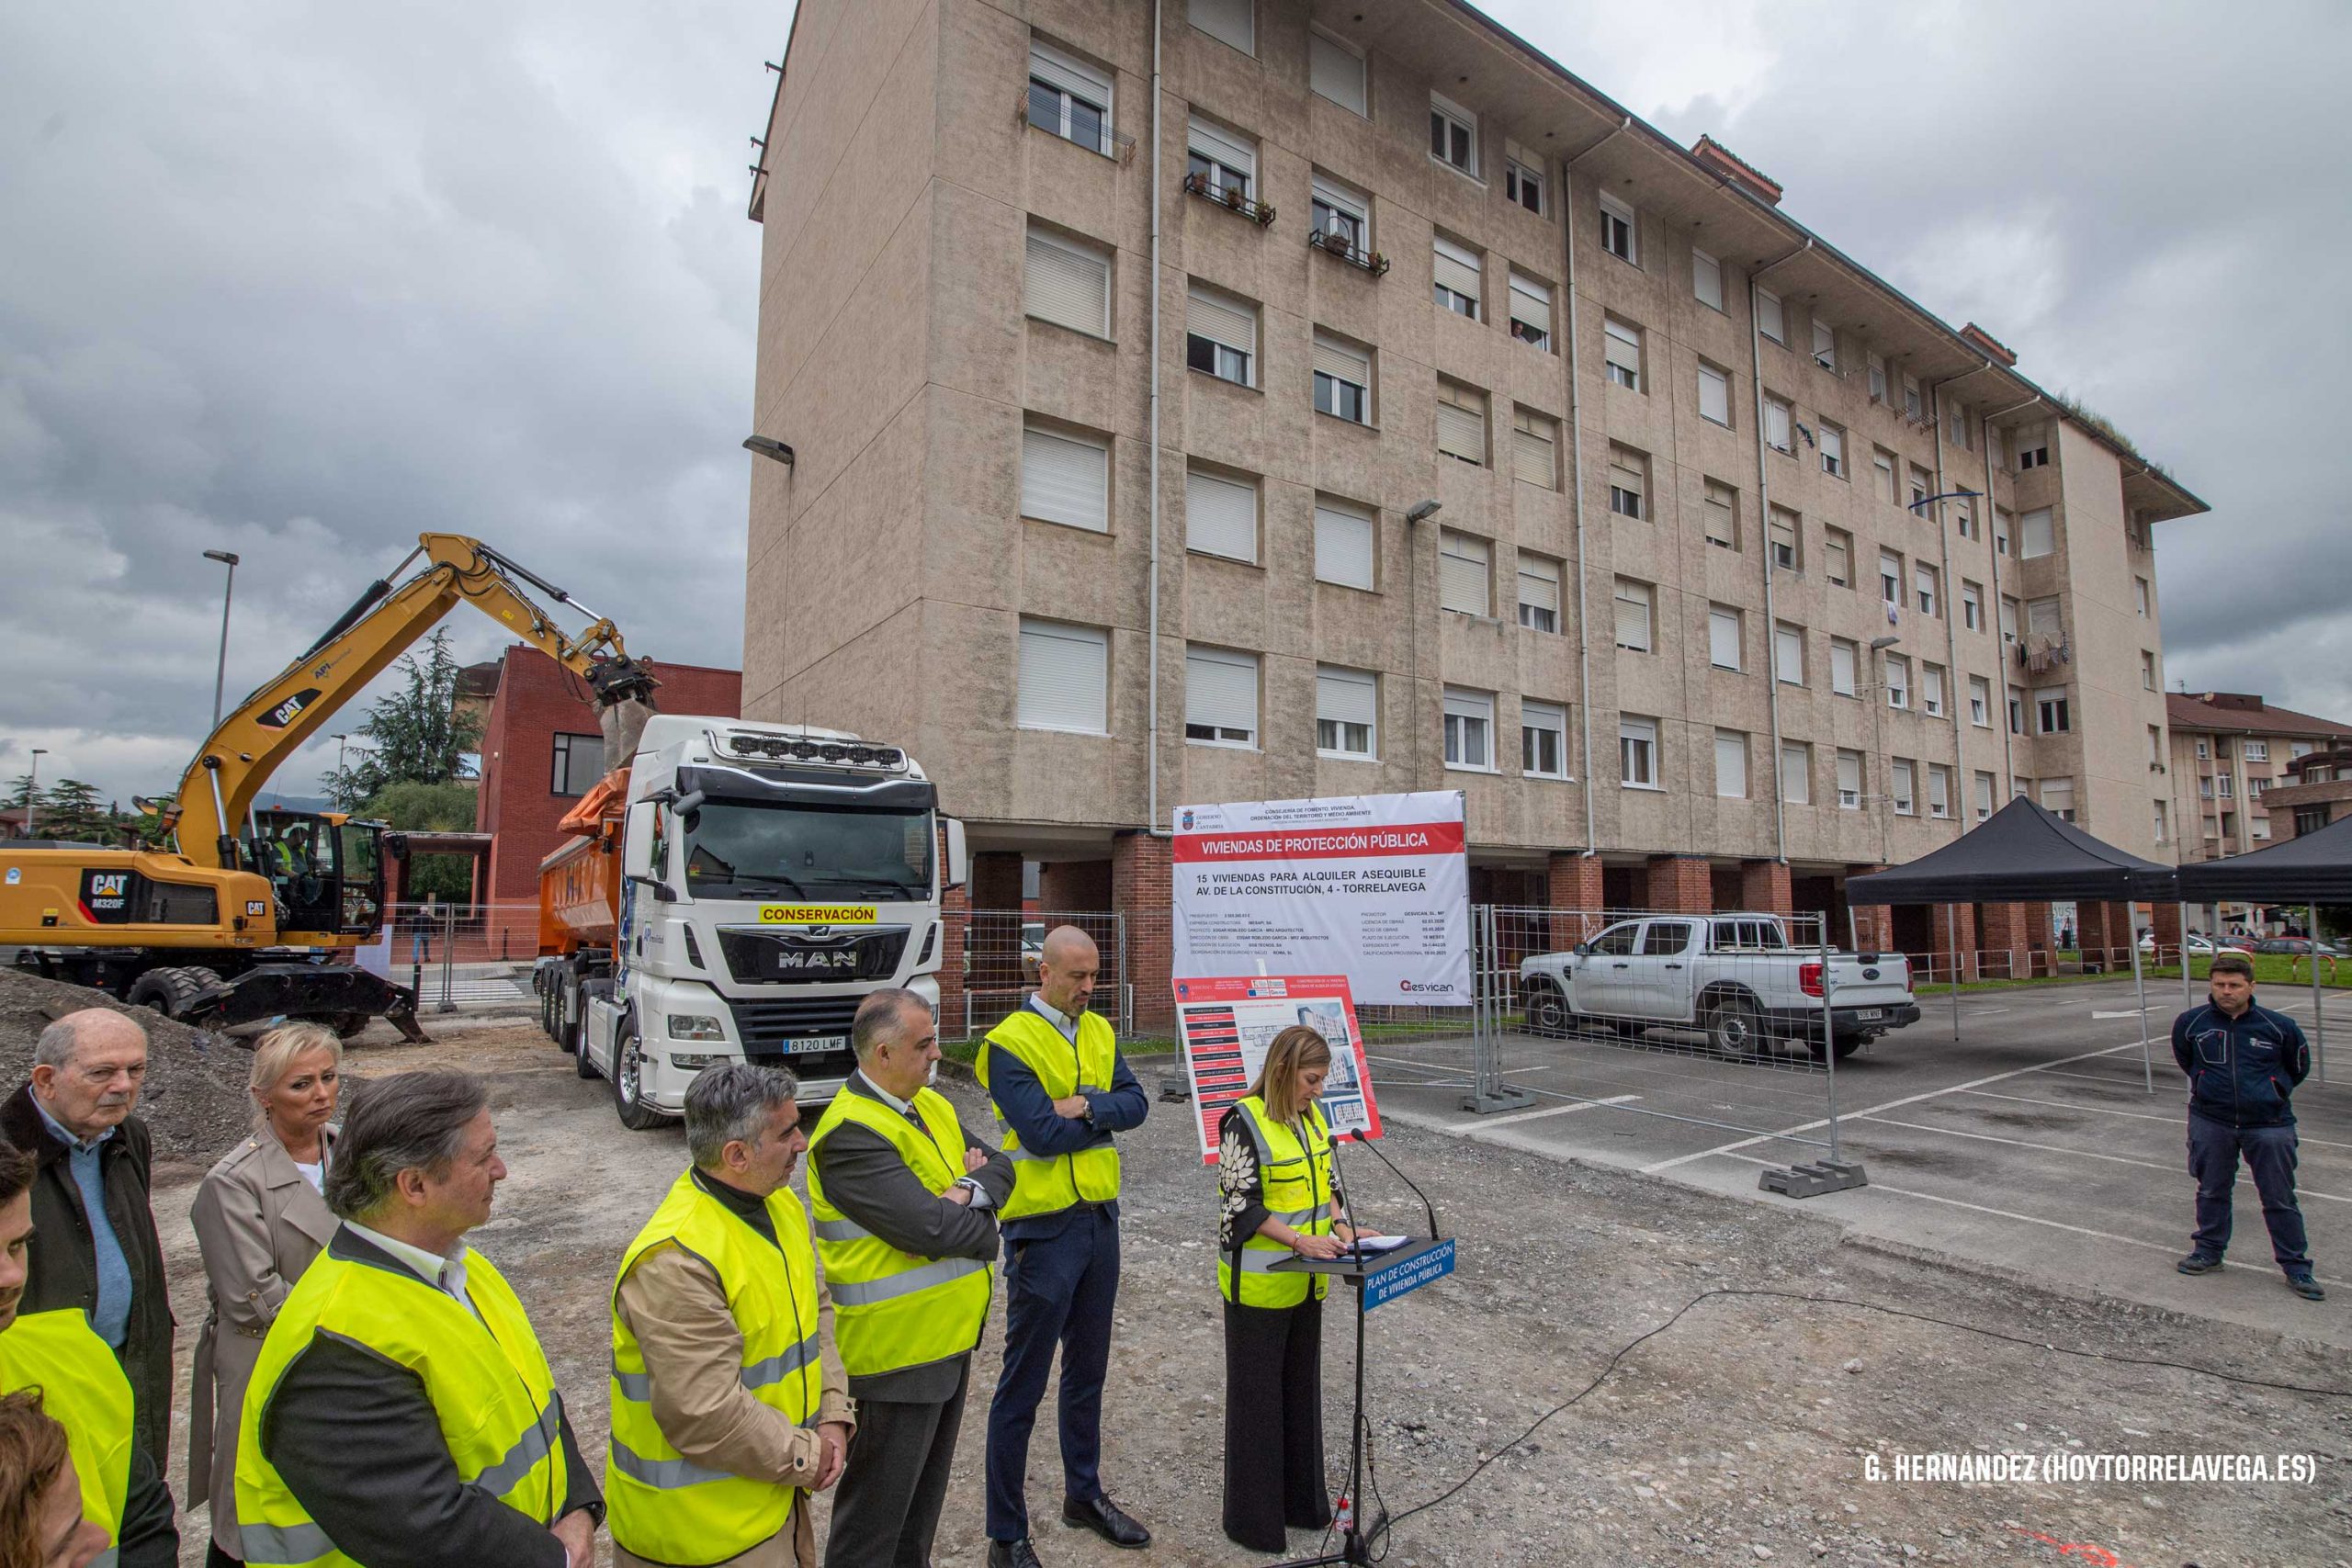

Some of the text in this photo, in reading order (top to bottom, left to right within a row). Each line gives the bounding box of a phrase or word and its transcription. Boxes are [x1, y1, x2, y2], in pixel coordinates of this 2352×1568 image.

[314, 663, 332, 680] API
[276, 696, 303, 725] CAT
[1202, 830, 1429, 854] VIVIENDAS DE PROTECCIÓN PÚBLICA
[1197, 868, 1427, 883] 15 VIVIENDAS PARA ALQUILER ASEQUIBLE
[92, 874, 128, 896] CAT
[1196, 886, 1211, 896] AV.
[1214, 886, 1227, 895] DE
[1230, 886, 1243, 895] LA
[1245, 883, 1325, 895] CONSTITUCIÓN,
[1327, 885, 1333, 893] 4
[1342, 882, 1427, 893] TORRELAVEGA
[92, 898, 125, 908] M320F
[247, 902, 265, 916] CAT
[763, 906, 874, 920] CONSERVACIÓN
[778, 951, 857, 968] MAN
[1400, 979, 1454, 992] Gesvican
[791, 1038, 842, 1052] 8120 LMF
[1367, 1243, 1453, 1291] PLAN DE CONSTRUCCIÓN
[1378, 1263, 1442, 1300] DE VIVIENDA PÚBLICA
